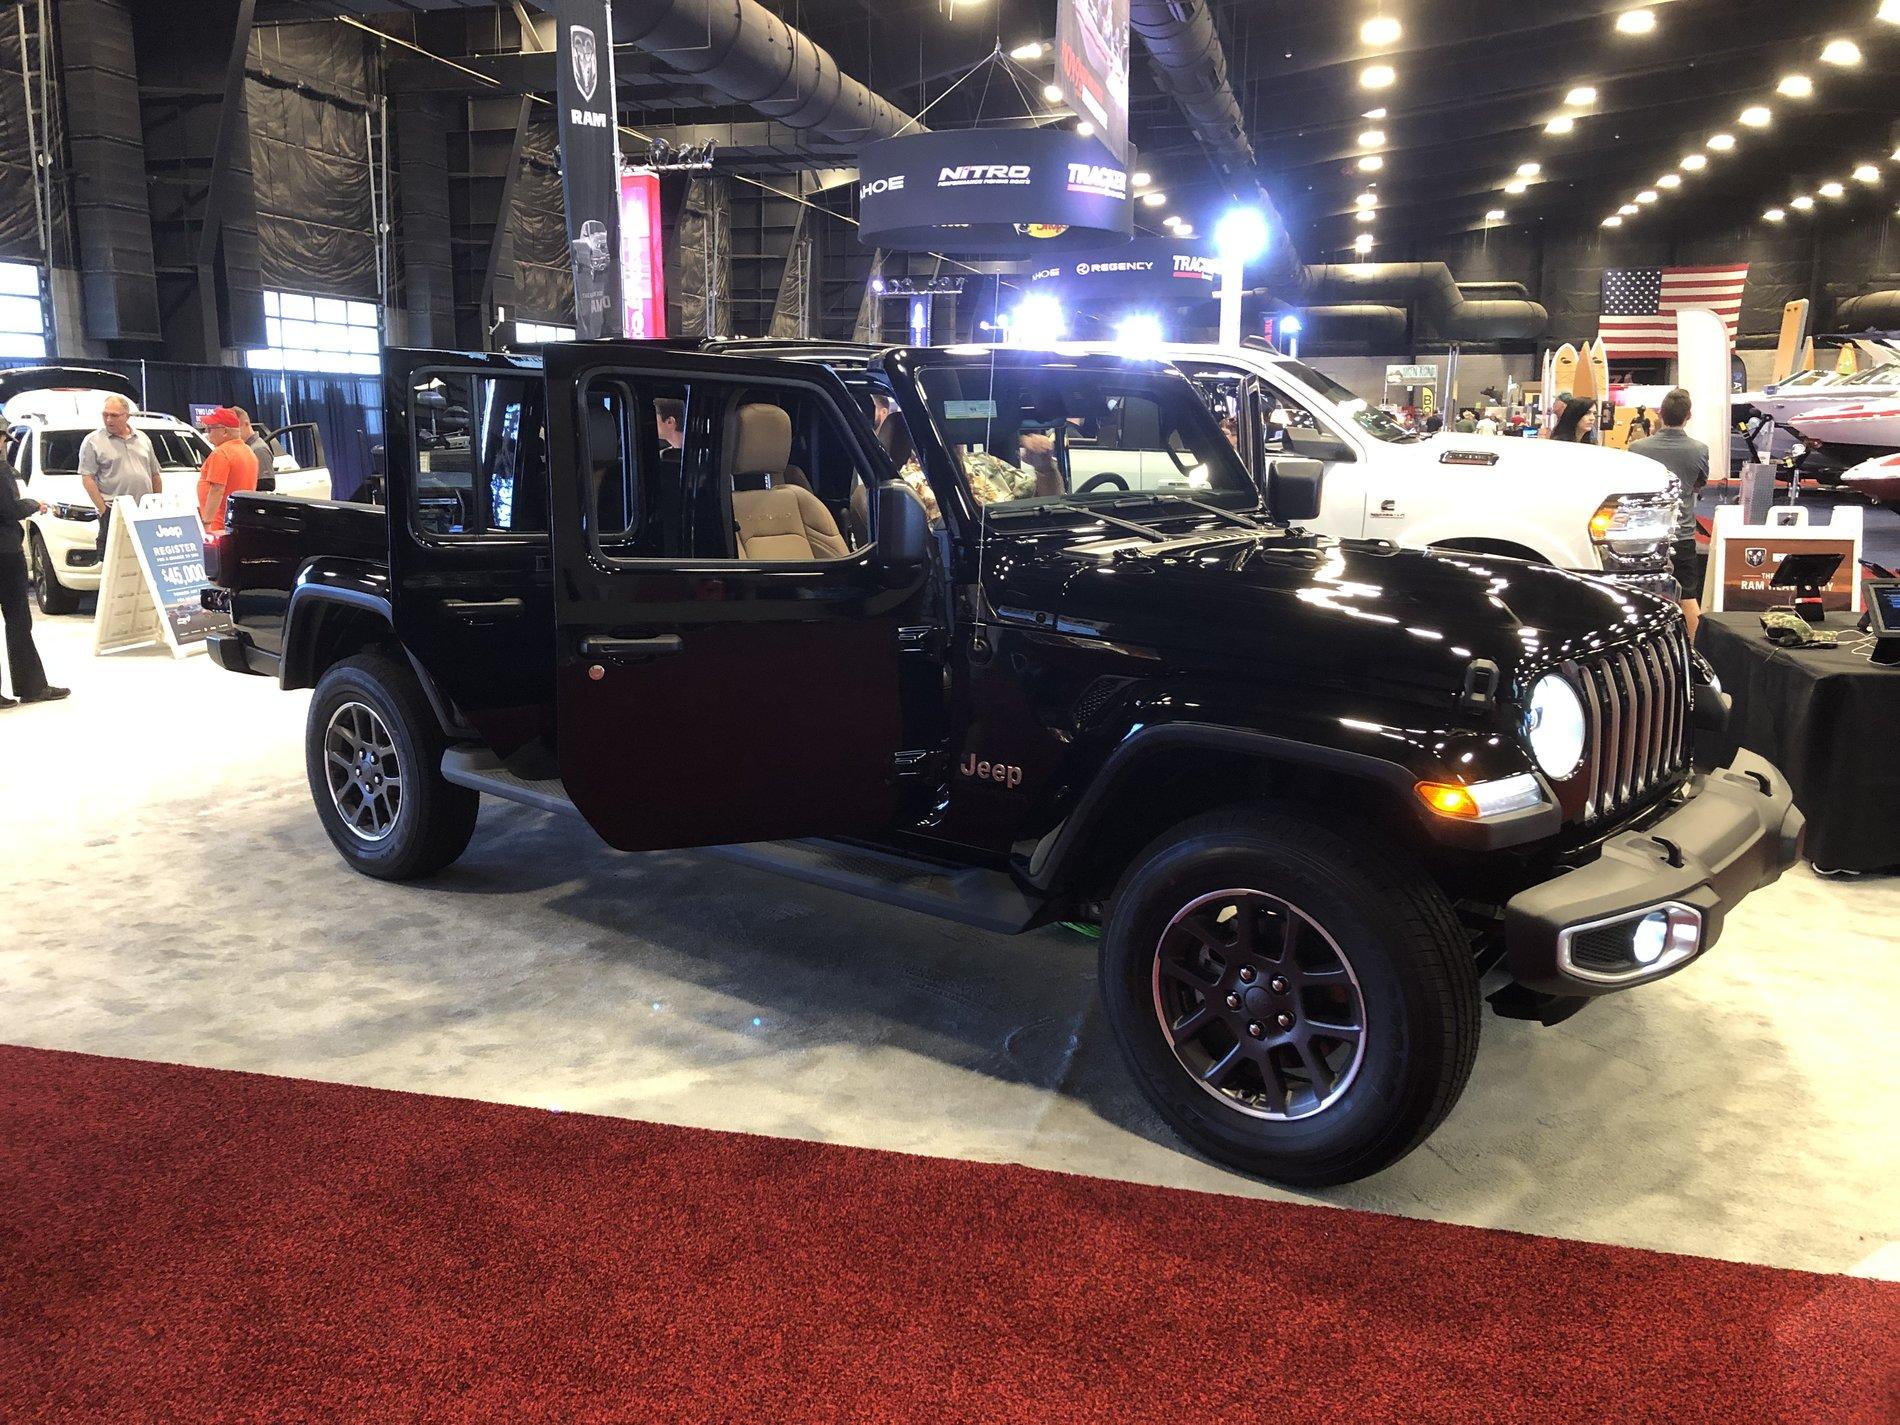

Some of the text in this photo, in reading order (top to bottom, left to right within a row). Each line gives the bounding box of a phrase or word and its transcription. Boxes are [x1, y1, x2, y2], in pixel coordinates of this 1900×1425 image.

[571, 109, 606, 127] RAM
[1091, 261, 1154, 273] REGENCY
[156, 525, 182, 538] Jeep
[153, 543, 197, 556] REGISTER
[161, 564, 207, 586] $45,000
[1741, 580, 1765, 591] RAM
[960, 753, 1022, 789] Jeep
